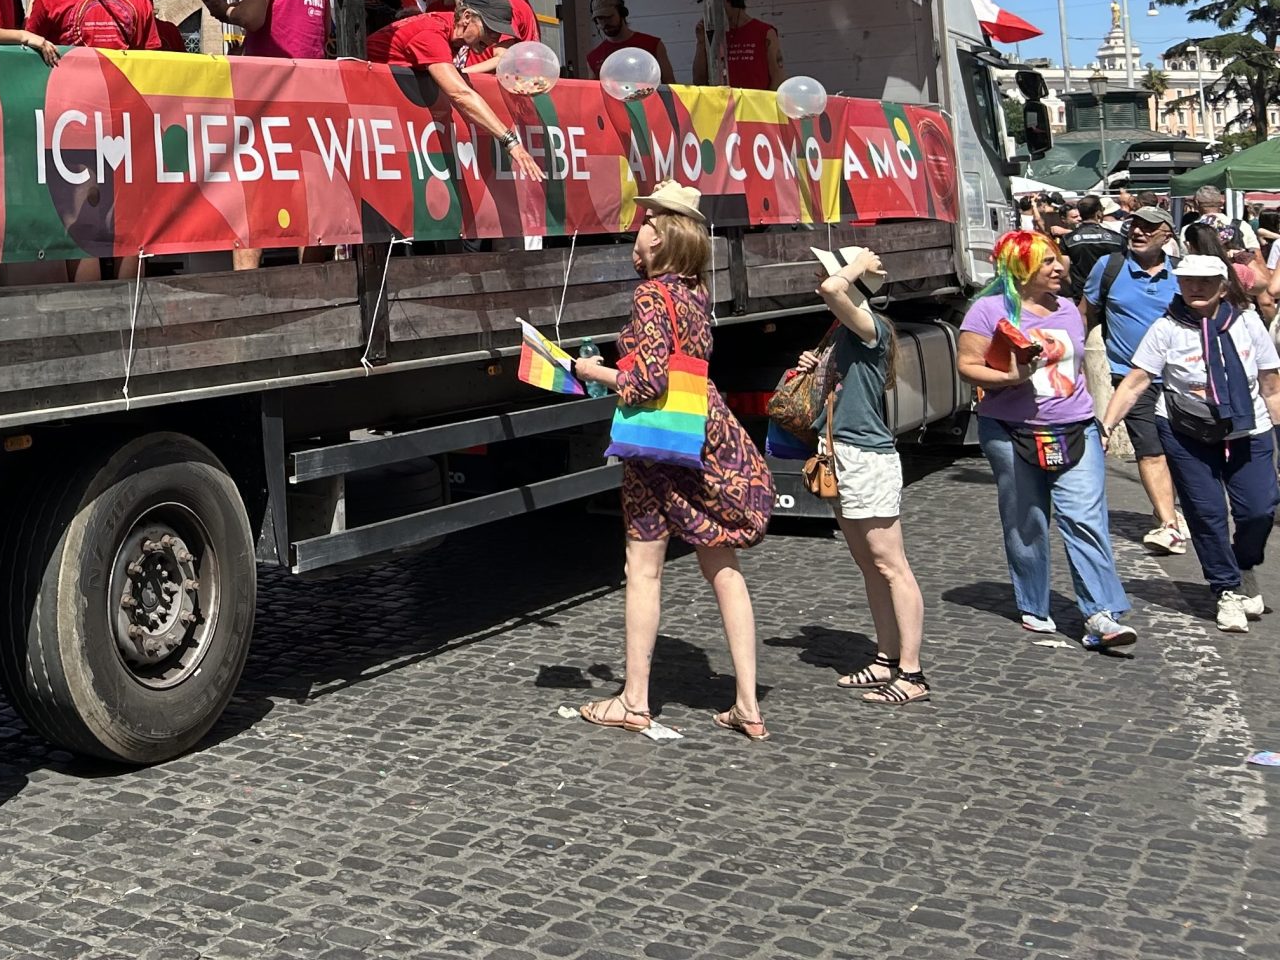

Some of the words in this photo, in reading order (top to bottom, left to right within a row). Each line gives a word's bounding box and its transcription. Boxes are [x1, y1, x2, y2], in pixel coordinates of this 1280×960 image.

[35, 109, 132, 184] ICH
[154, 113, 300, 183] LIEBE
[308, 116, 401, 182] WIE
[406, 120, 480, 180] ICH
[627, 130, 702, 182] AMO
[725, 133, 823, 182] COMO
[843, 137, 918, 182] AMO
